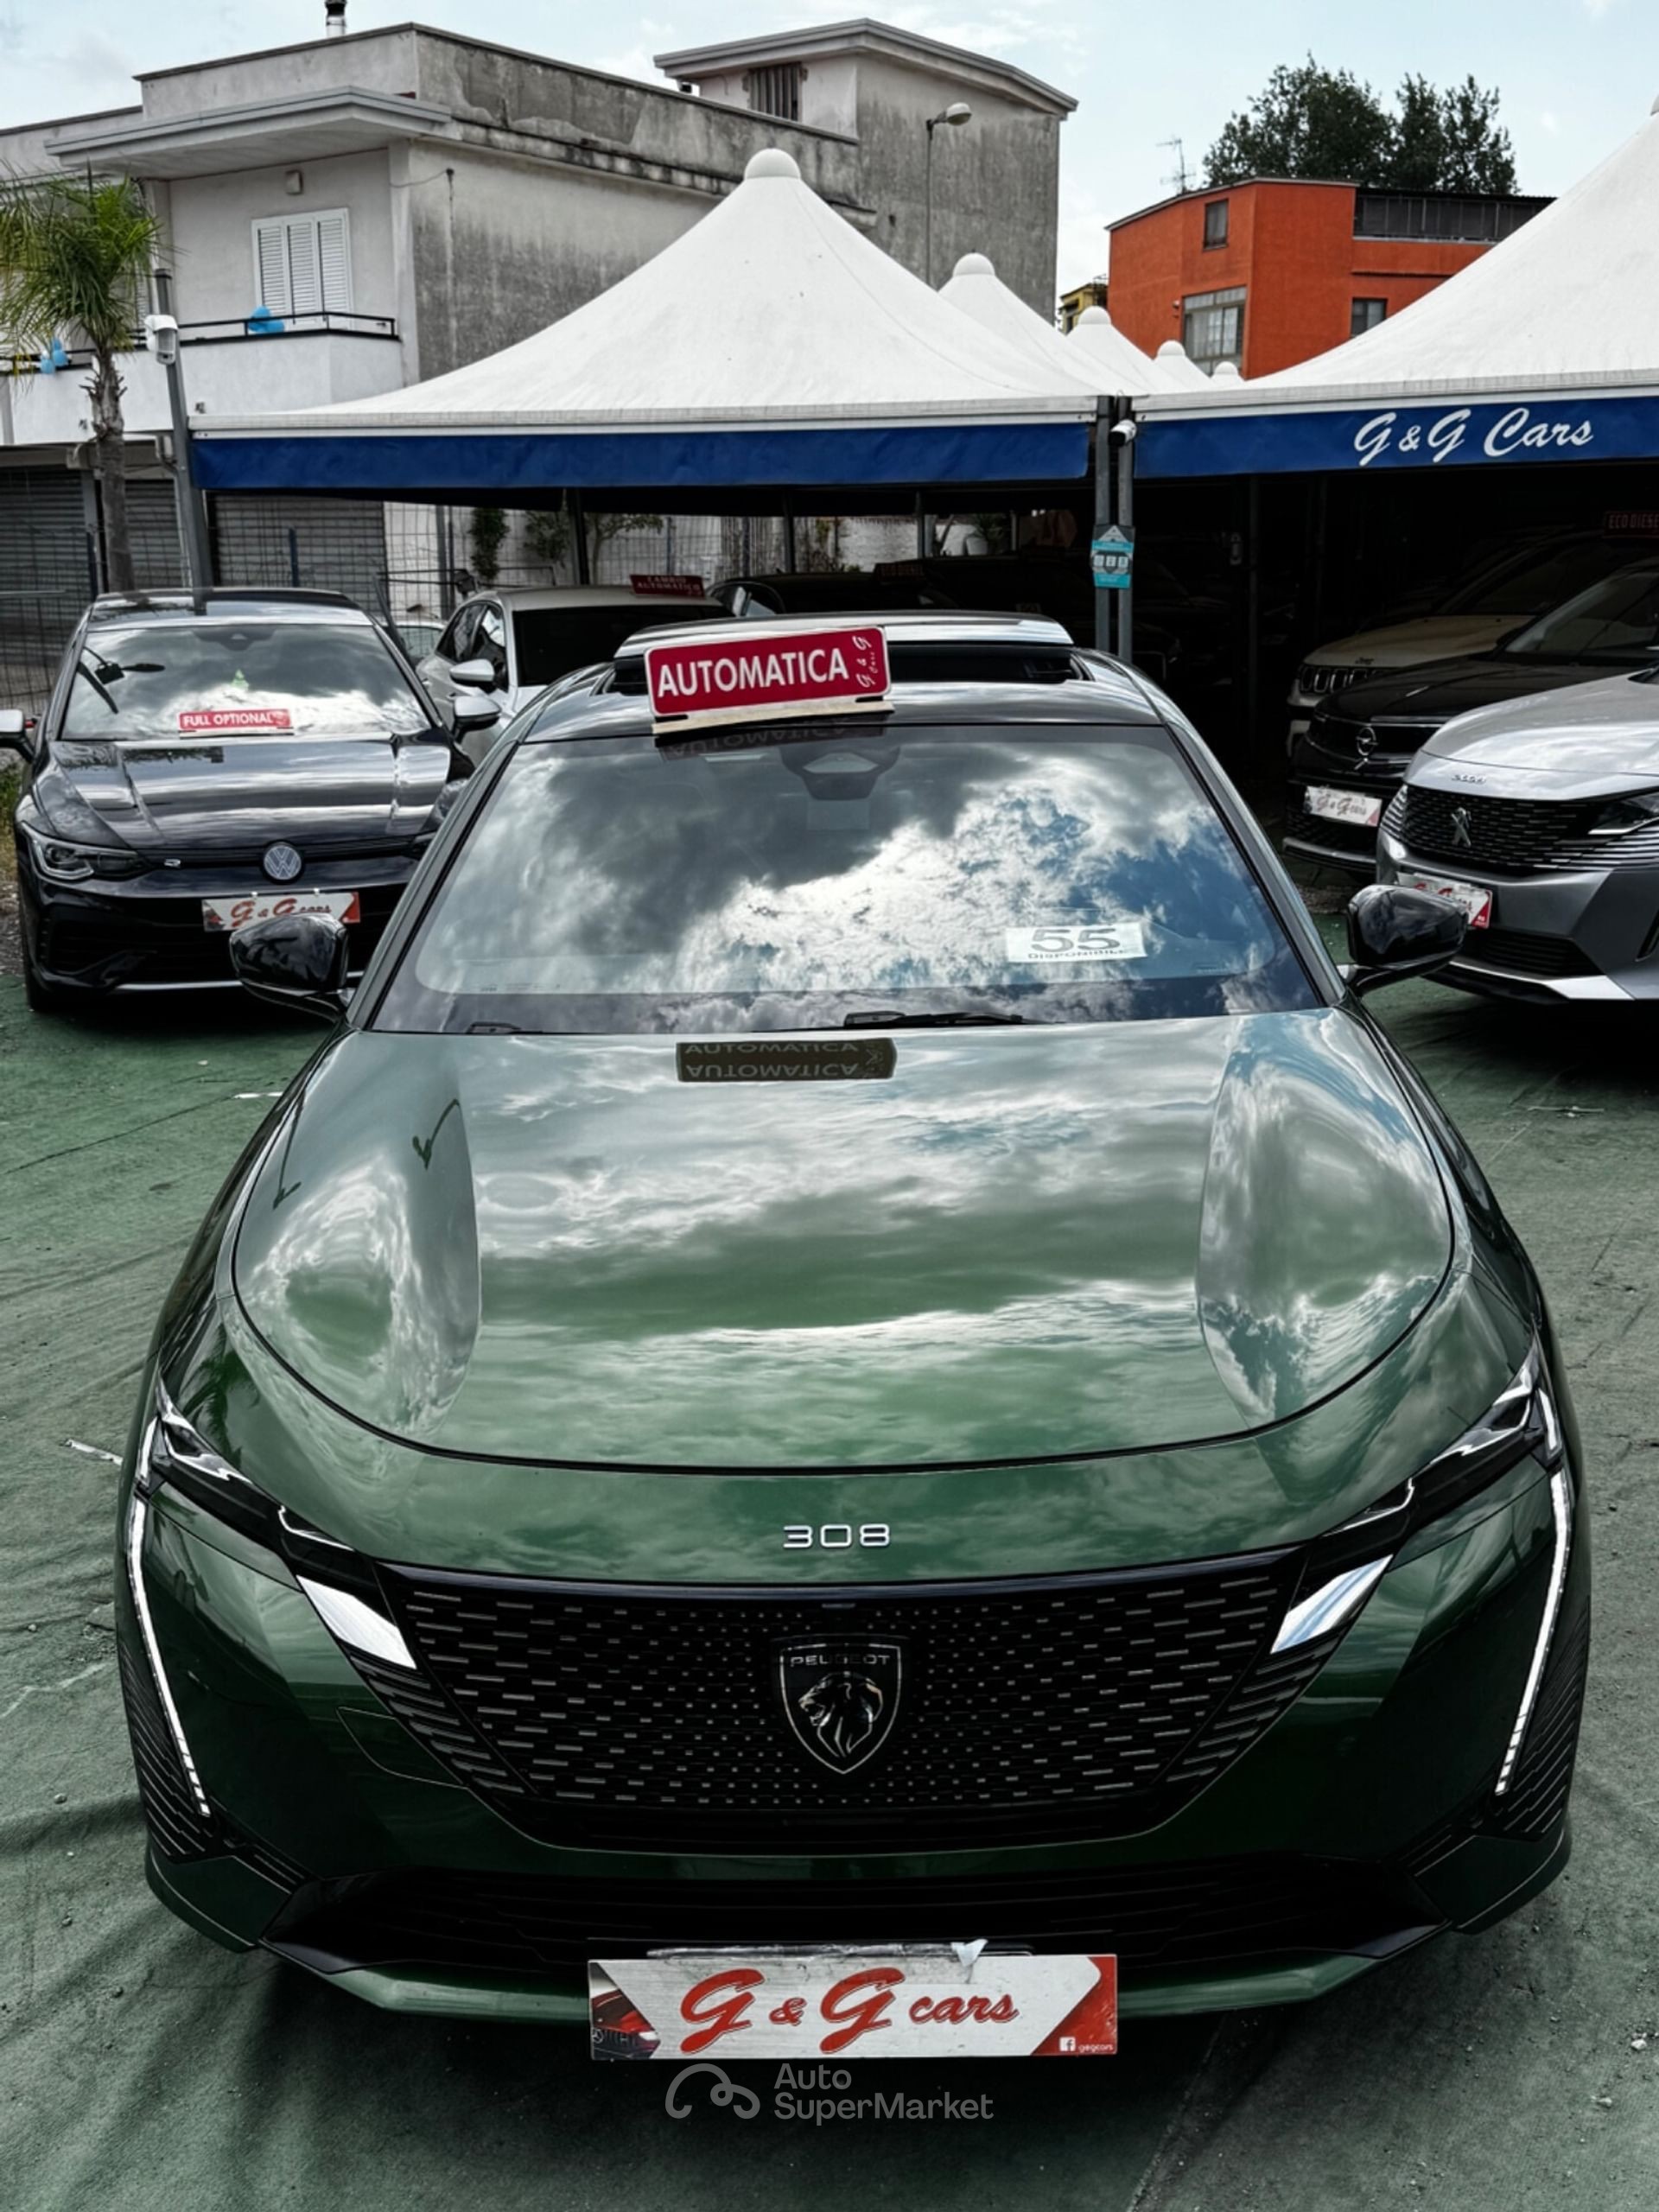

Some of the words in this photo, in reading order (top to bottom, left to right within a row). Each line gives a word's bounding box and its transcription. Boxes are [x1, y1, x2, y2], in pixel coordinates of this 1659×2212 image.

[1354, 412, 1396, 467] G
[1398, 425, 1421, 452] &
[1427, 409, 1471, 463] G
[1483, 407, 1594, 457] Cars
[658, 648, 849, 697] AUTOMATICA
[183, 715, 211, 727] FULL
[213, 712, 273, 726] OPTIONAL
[1031, 928, 1121, 952] 55
[783, 1523, 890, 1548] 308
[679, 1967, 766, 2055] G
[769, 1996, 807, 2026] &
[818, 1967, 906, 2055] G
[908, 1993, 1020, 2024] cars
